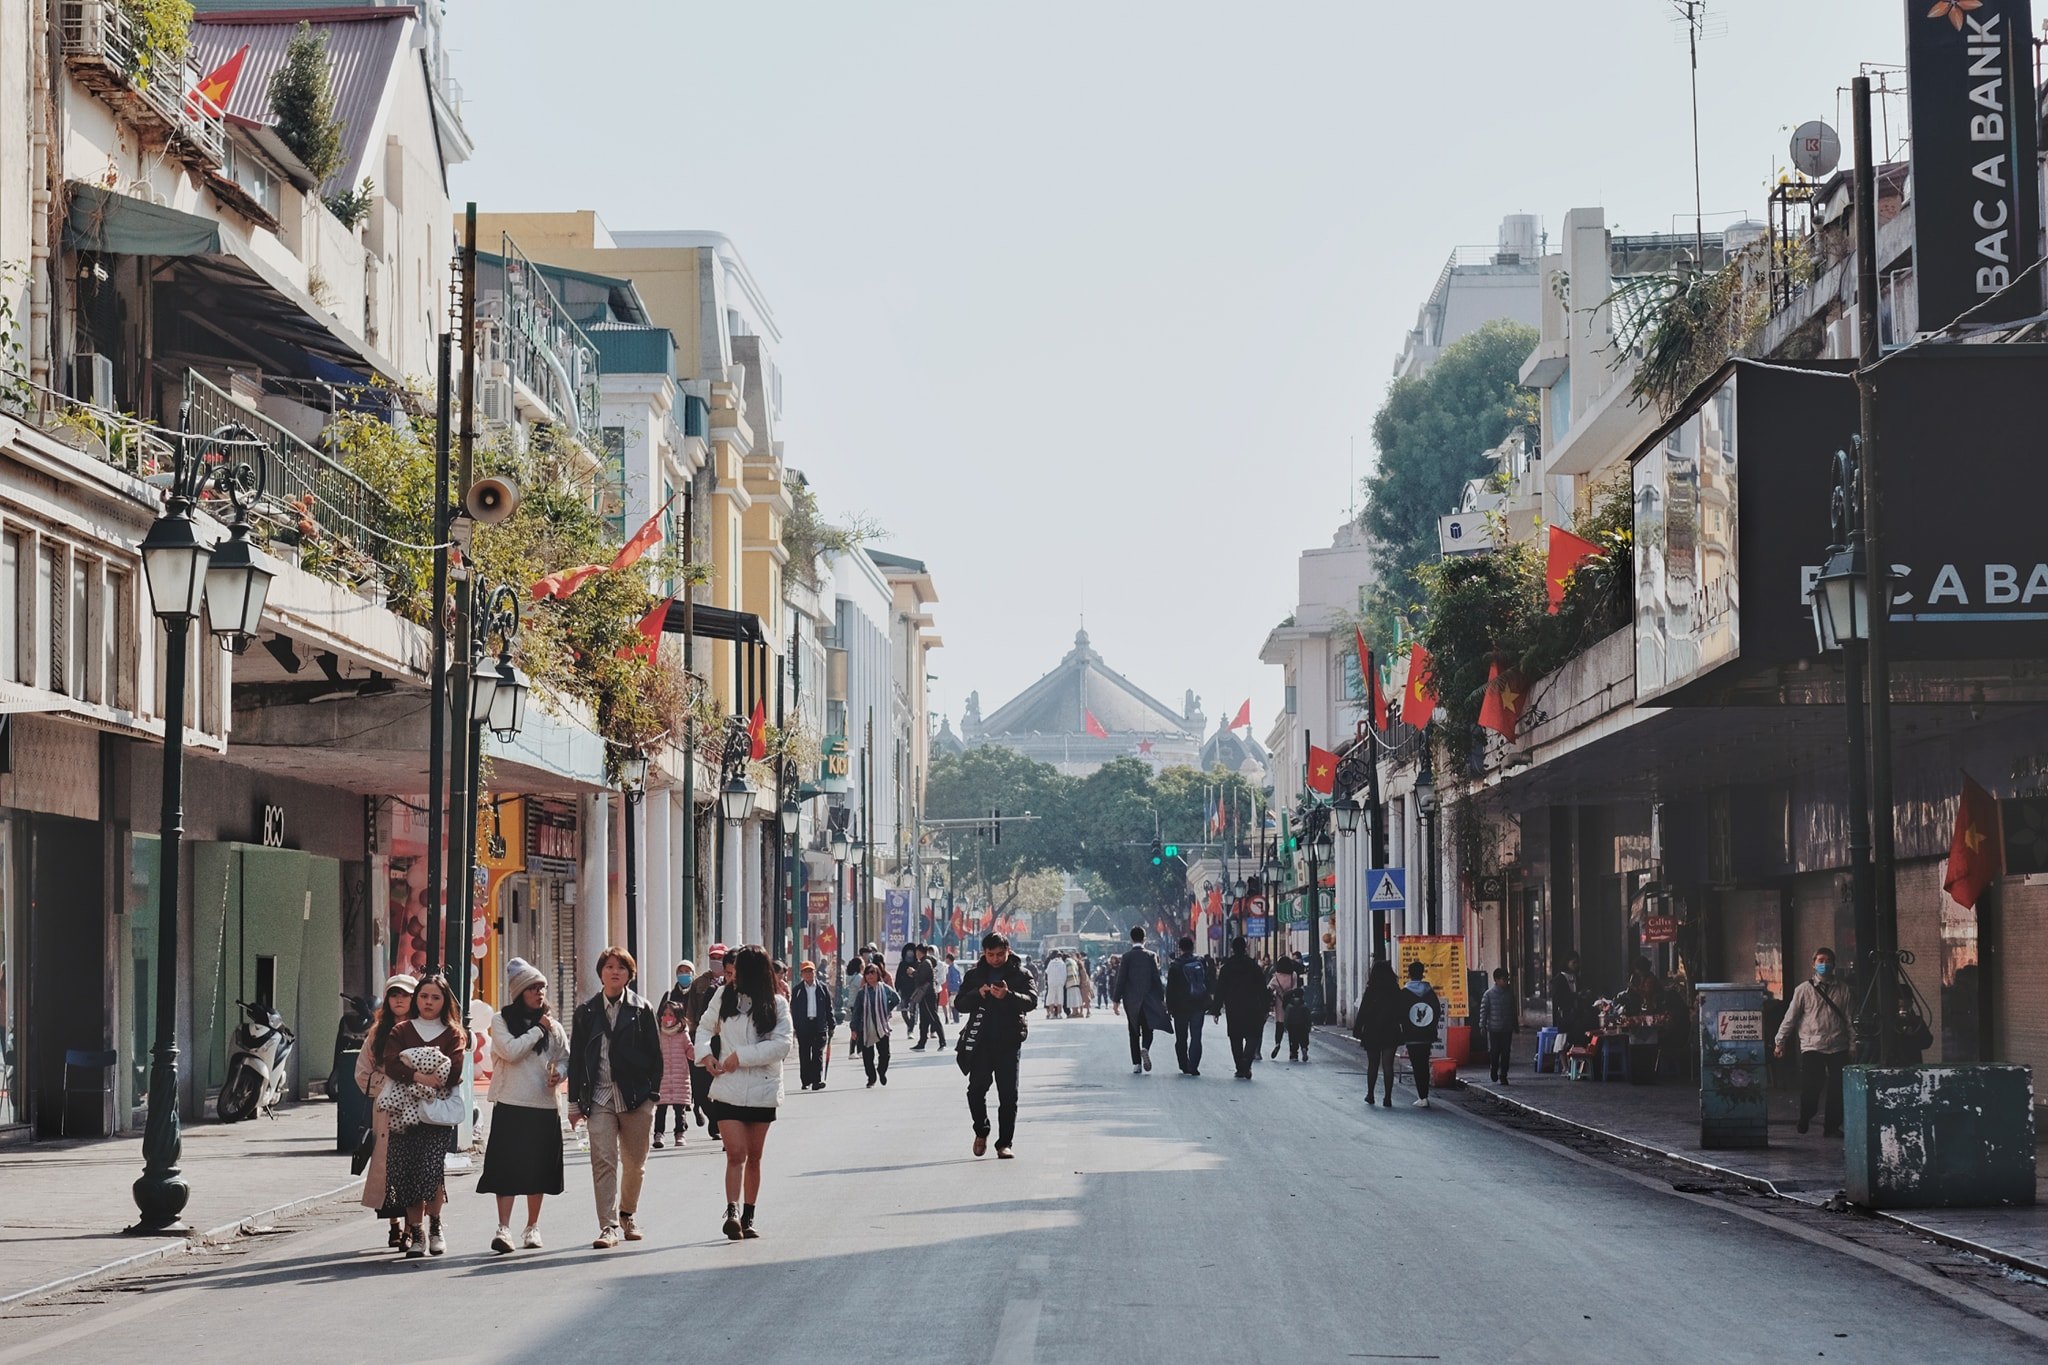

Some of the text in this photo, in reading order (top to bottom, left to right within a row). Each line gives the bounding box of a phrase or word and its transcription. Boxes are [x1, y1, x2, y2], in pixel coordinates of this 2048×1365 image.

[1966, 13, 2010, 294] BAC A BANK
[1928, 564, 1969, 605] A
